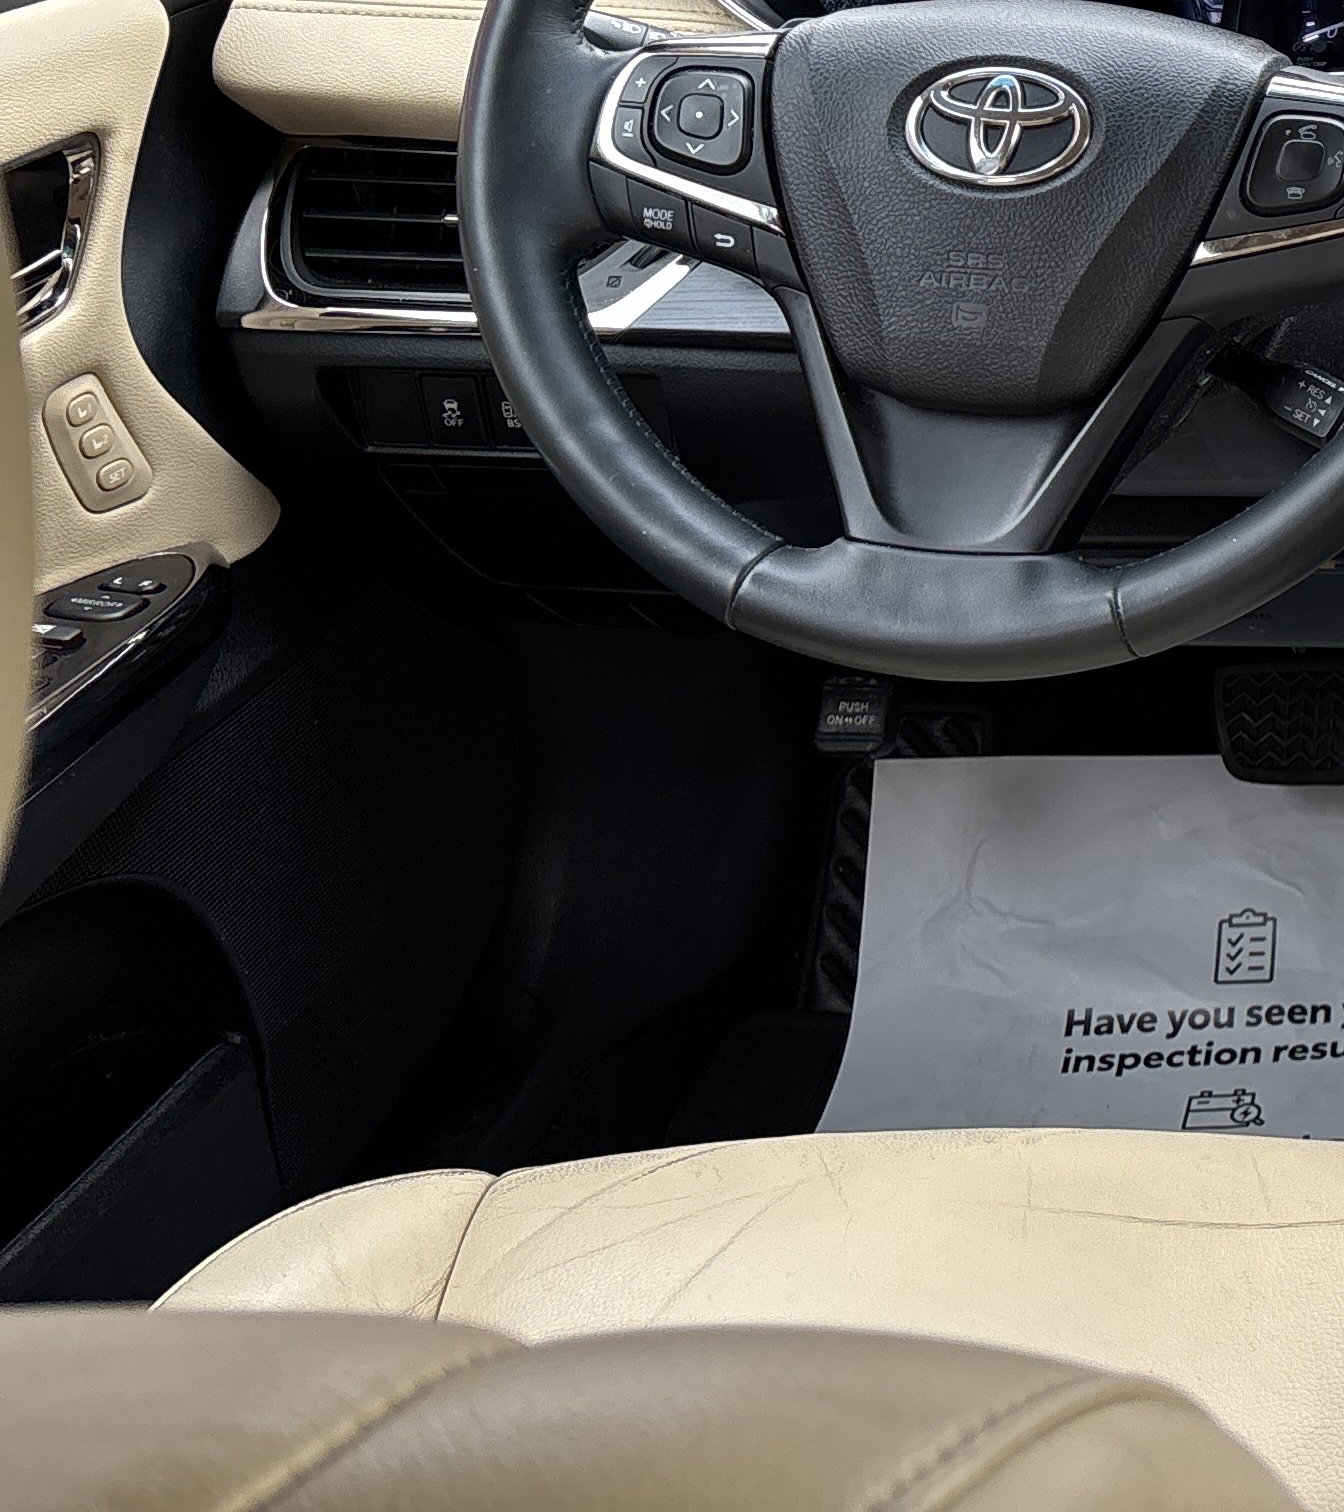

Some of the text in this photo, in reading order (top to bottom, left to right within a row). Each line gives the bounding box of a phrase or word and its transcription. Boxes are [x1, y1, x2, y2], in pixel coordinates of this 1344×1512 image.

[643, 208, 674, 223] MODE
[919, 270, 1030, 293] AIRBAG
[444, 418, 464, 427] OFF
[108, 467, 127, 484] SET
[838, 701, 869, 713] PUSH
[1064, 1007, 1158, 1038] Have
[1165, 1005, 1235, 1040] you
[1245, 1002, 1332, 1027] seen
[1061, 1041, 1261, 1077] inspection
